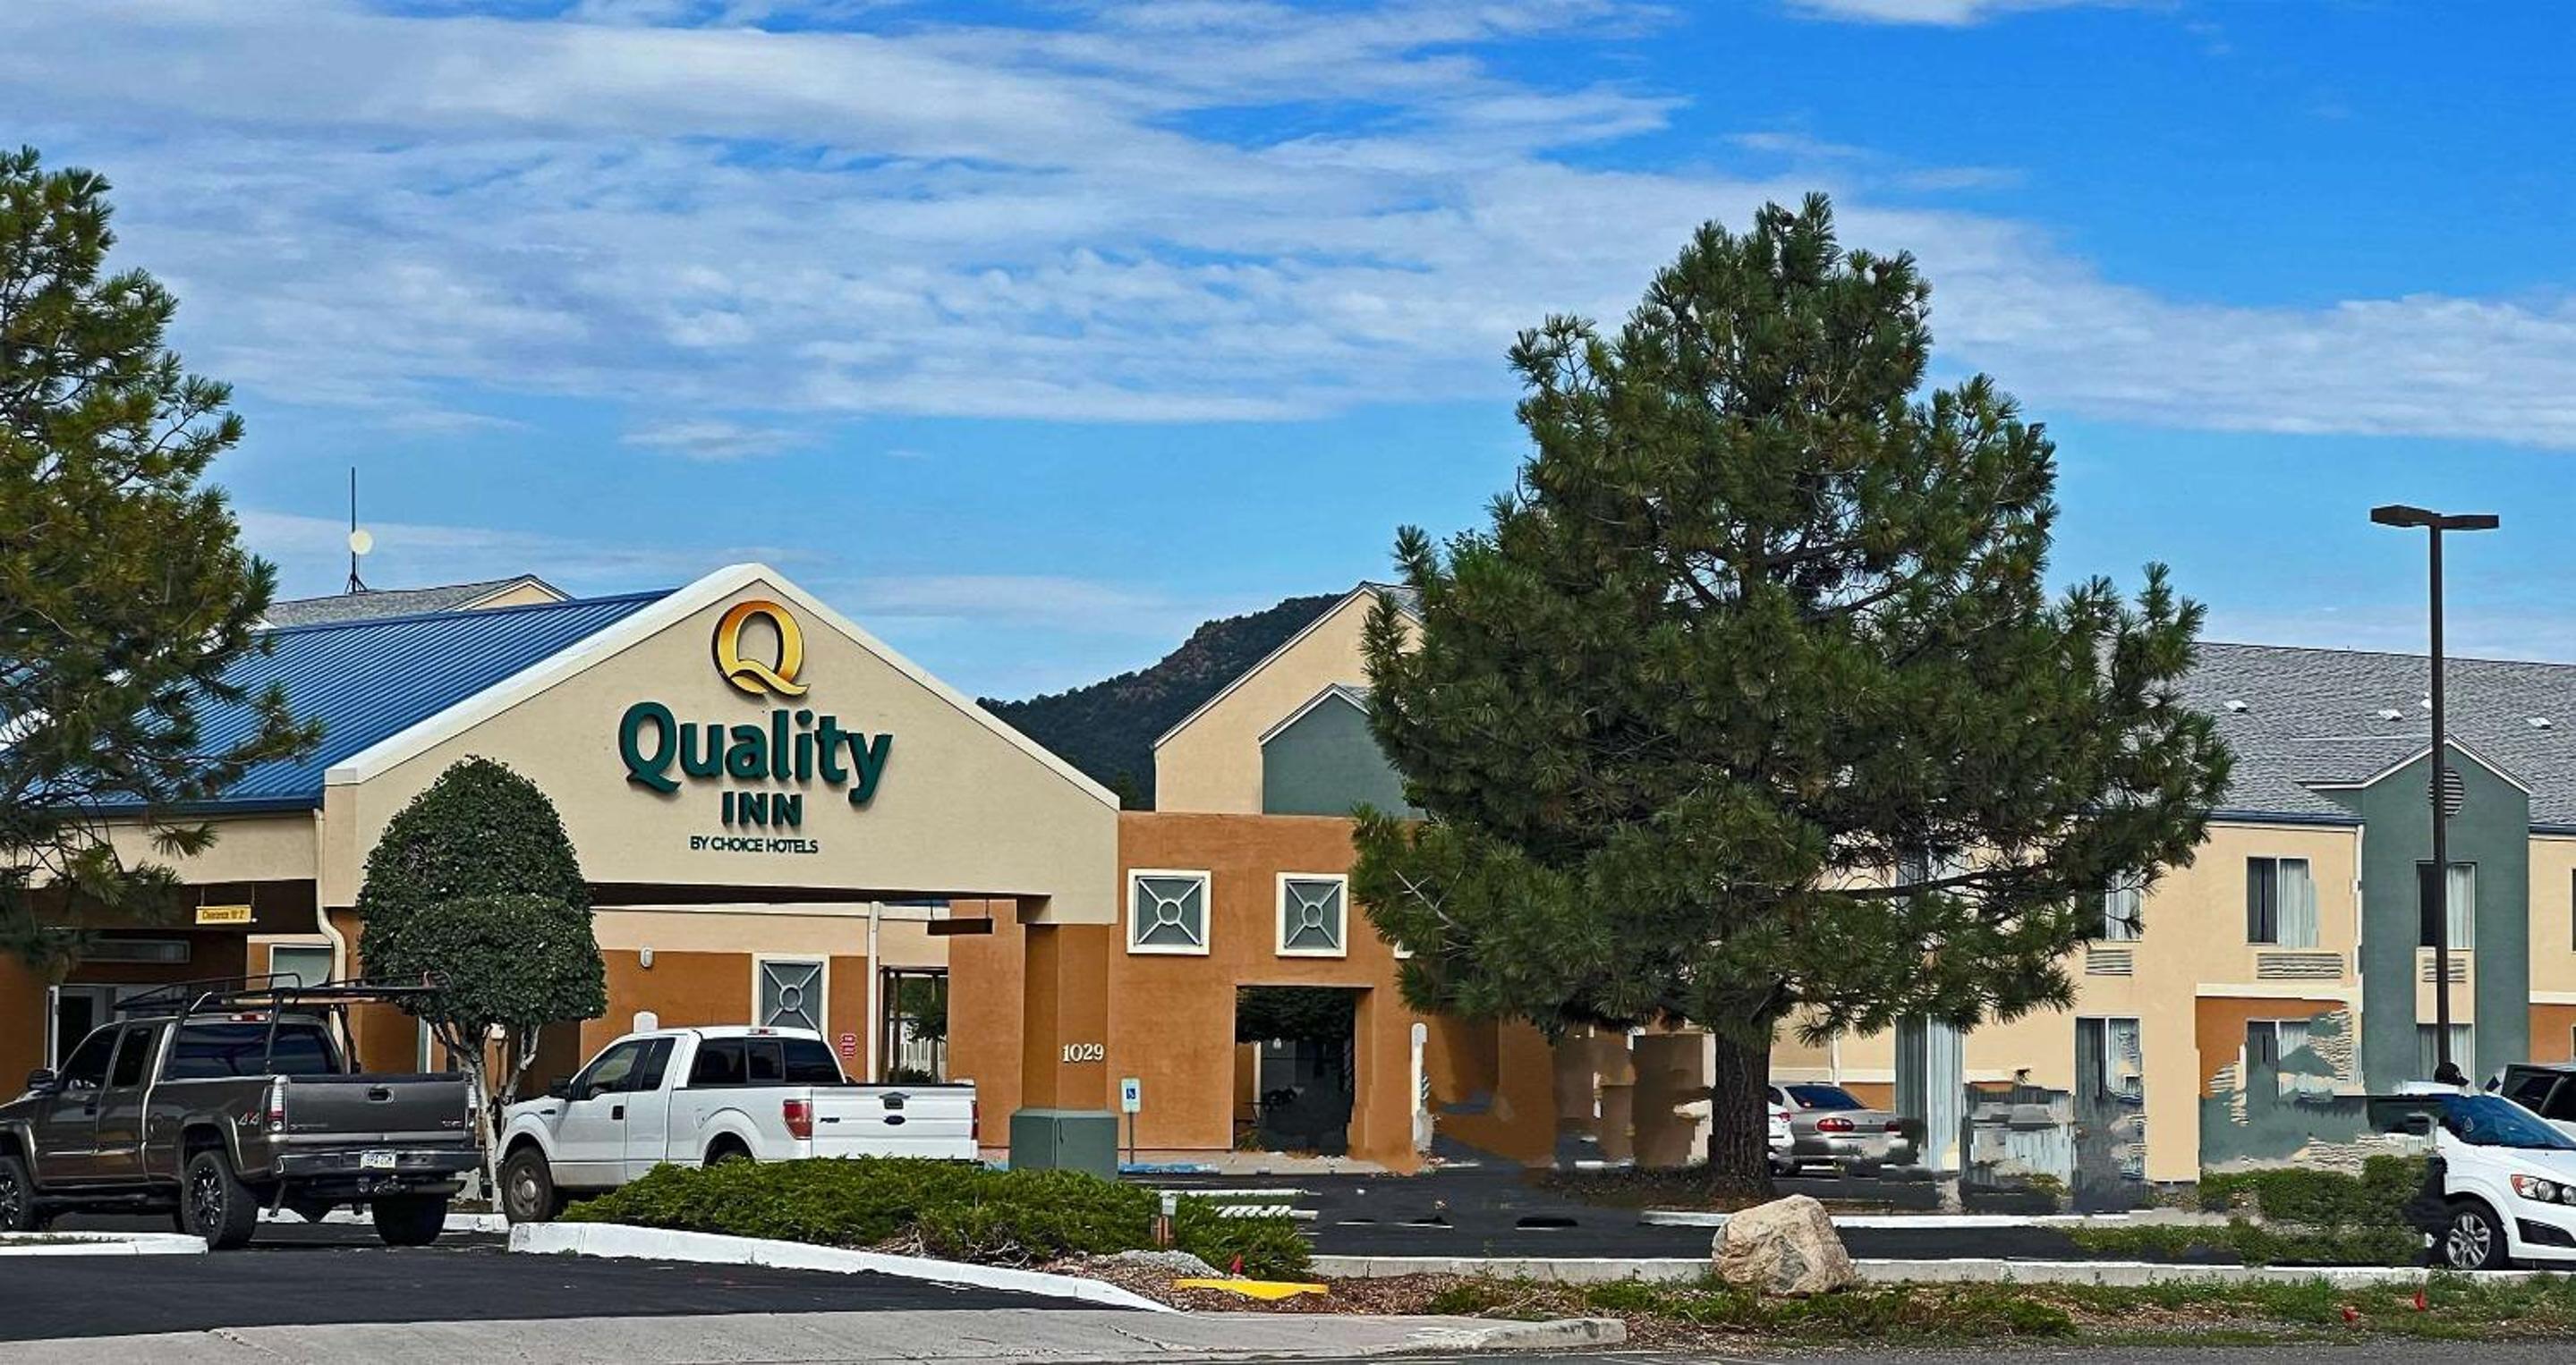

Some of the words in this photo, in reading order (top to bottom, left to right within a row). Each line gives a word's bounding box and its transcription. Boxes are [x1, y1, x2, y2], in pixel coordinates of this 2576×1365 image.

[711, 599, 811, 697] Q
[618, 701, 893, 804] Quality
[721, 791, 803, 827] INN
[690, 835, 710, 850] BY
[711, 837, 763, 852] CHOICE
[766, 838, 819, 853] HOTELS
[1062, 1043, 1105, 1063] 1029
